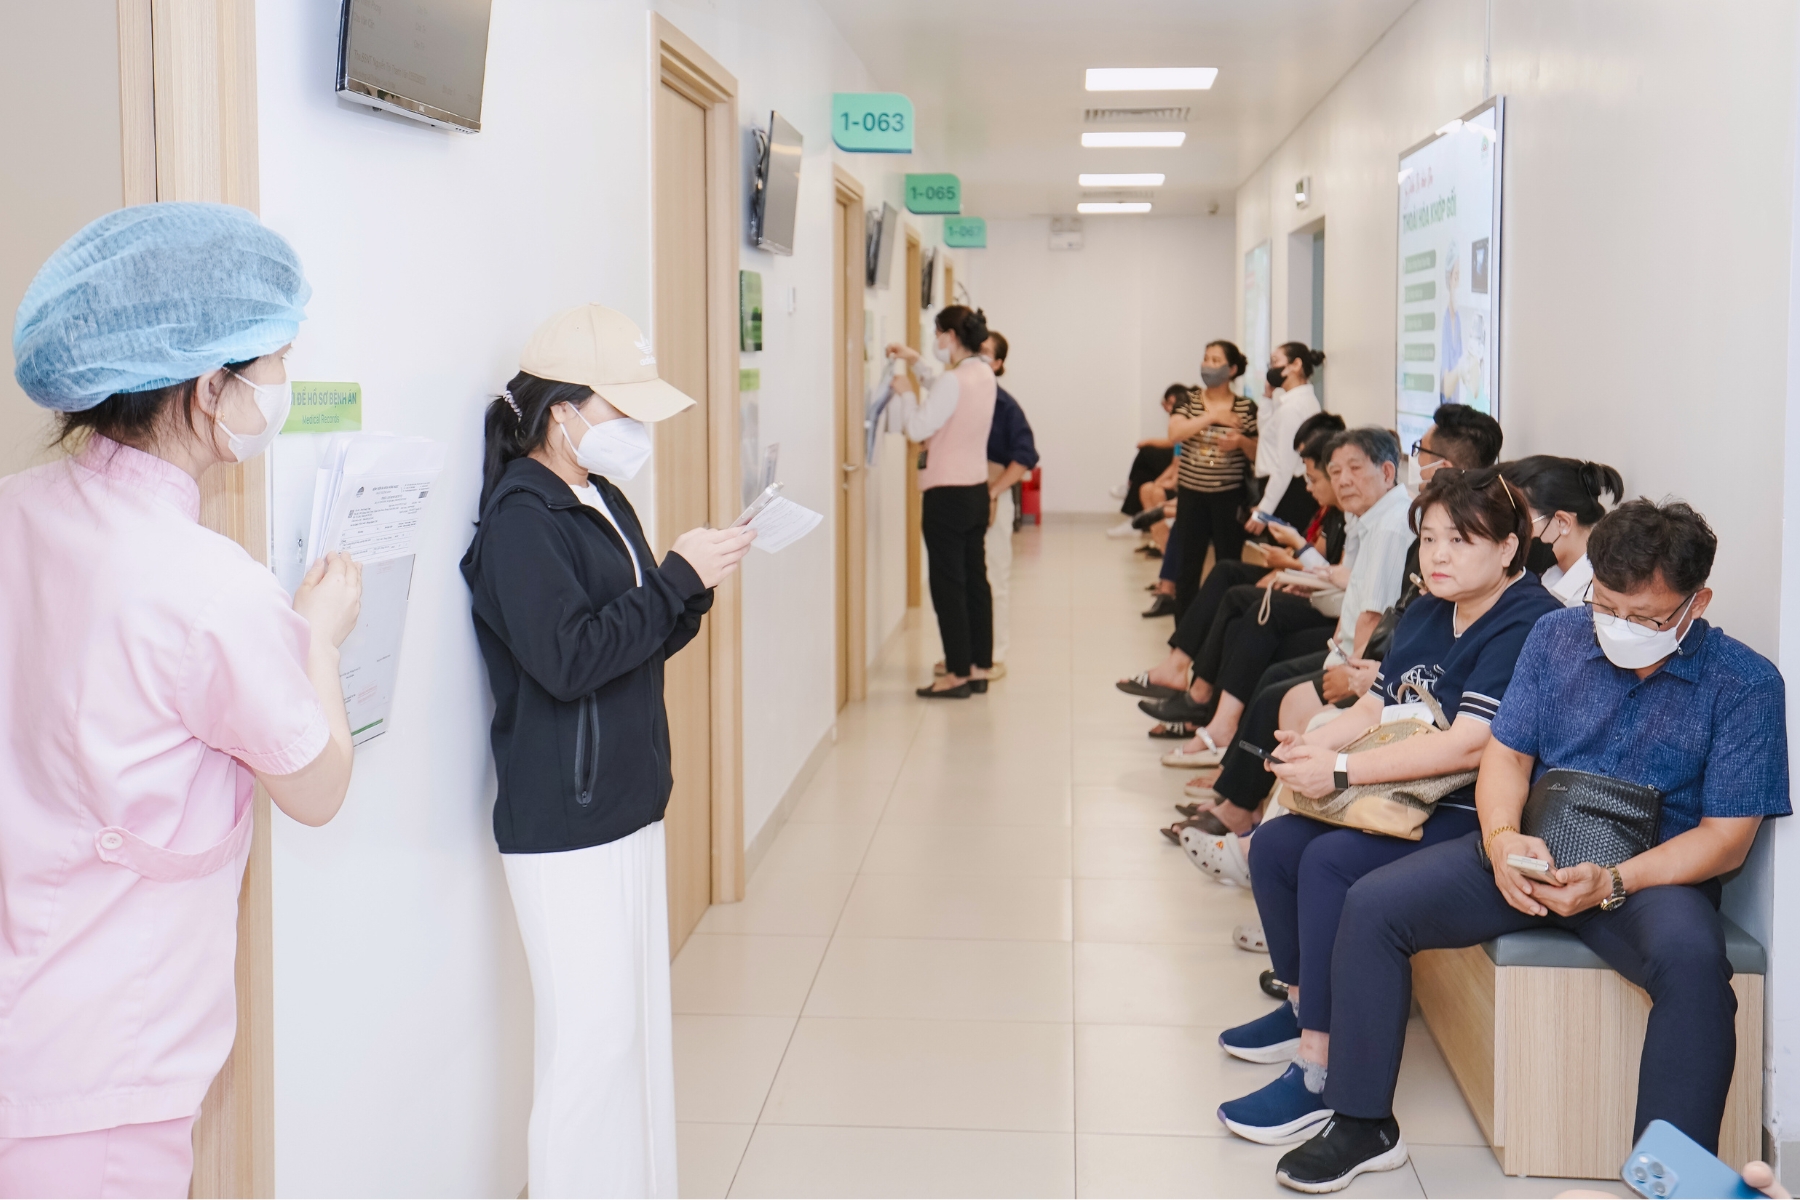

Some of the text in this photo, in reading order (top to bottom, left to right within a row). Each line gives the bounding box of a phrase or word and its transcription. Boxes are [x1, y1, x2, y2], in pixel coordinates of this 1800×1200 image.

[840, 112, 905, 132] 1-063
[910, 186, 956, 200] 1-065
[297, 386, 306, 405] ĐỂ
[307, 387, 317, 405] HỒ
[318, 390, 329, 405] SƠ
[329, 389, 347, 408] BỆNH
[347, 389, 357, 405] ÁN
[302, 414, 340, 425] Medical Records
